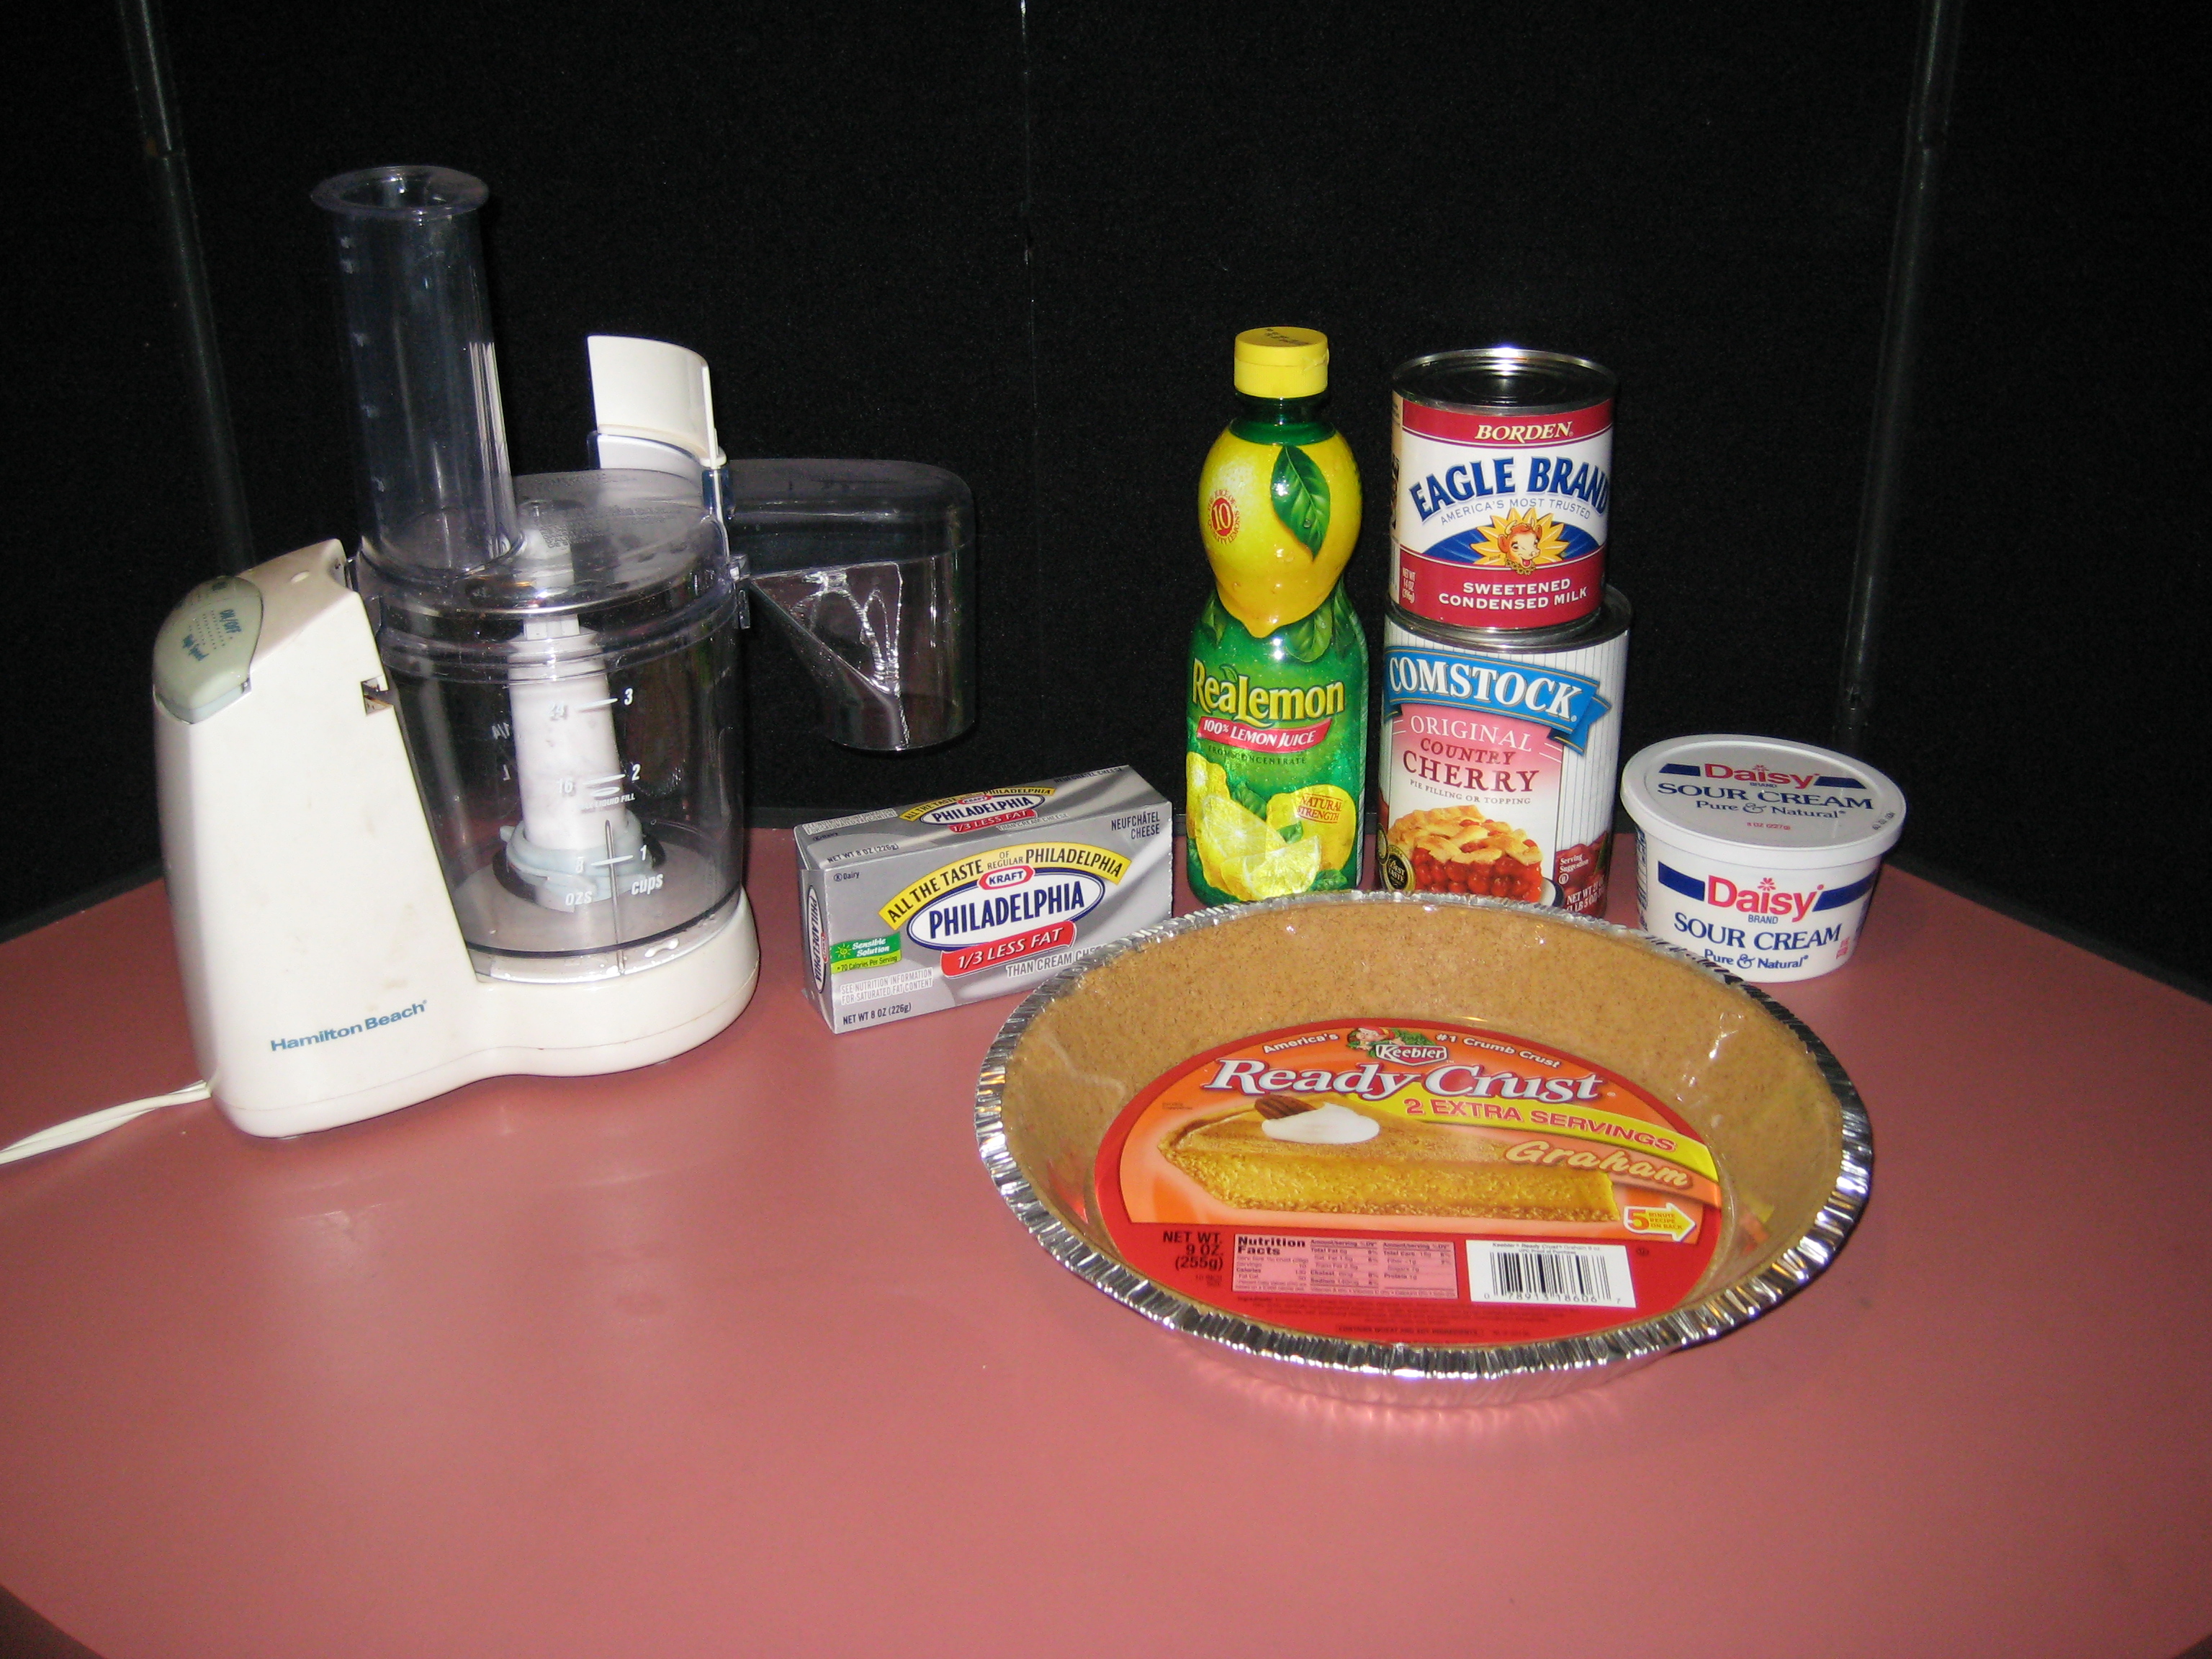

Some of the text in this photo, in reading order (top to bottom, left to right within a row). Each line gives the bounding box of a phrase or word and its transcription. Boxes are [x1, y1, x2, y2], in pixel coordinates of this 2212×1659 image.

[1475, 421, 1572, 444] BORDEN
[1408, 455, 1611, 523] EAGLE BRAND
[1213, 503, 1231, 529] 10
[1441, 498, 1591, 526] AMERICA'S MOST TRUSTED
[1439, 585, 1588, 610] CONDENSED MILK
[1462, 578, 1571, 596] SWEETENED
[624, 688, 634, 705] 3
[1192, 657, 1345, 728] ReaLemon
[1388, 655, 1583, 721] COMSTOCK
[1203, 719, 1316, 750] 100% LEMON JUICE
[1410, 714, 1532, 752] ORIGINAL
[1420, 737, 1516, 765] COUNTRY
[631, 763, 641, 781] 2
[1403, 750, 1539, 793] CHERRY
[1704, 763, 1817, 790] Daisy
[621, 793, 636, 804] FILL
[1410, 778, 1423, 790] PIE
[1425, 783, 1462, 801] FILLING
[1465, 795, 1480, 804] OR
[1658, 782, 1874, 810] SOUR CREAM
[904, 810, 917, 820] ALL
[916, 802, 932, 813] THE
[932, 797, 957, 807] TASTE
[932, 796, 1033, 823] PHILADELPHIA
[1297, 806, 1339, 821] STRENGTH
[1300, 796, 1342, 812] NATURAL
[1696, 800, 1839, 819] Pure & Natural
[953, 810, 1028, 833] 1/3 LESS FAT
[998, 814, 1068, 832] THAN CREAM CHEESE
[1130, 823, 1160, 840] CHEESE
[827, 853, 842, 863] NET
[874, 843, 900, 853] (226g)
[987, 856, 1024, 871] REGULAR
[999, 850, 1010, 859] OF
[843, 871, 860, 880] Dairy
[887, 848, 1123, 923] ALL THE TASTE PHILADELPHIA
[988, 871, 1024, 886] KRAFT
[1566, 891, 1582, 905] NET
[1707, 874, 1817, 922] Daisy
[929, 881, 1085, 939] PHILADELPHIA
[1748, 914, 1779, 924] BRAND
[809, 895, 822, 983] PHILADELPHIA
[1674, 912, 1745, 950] SOUR
[1753, 922, 1843, 951] CREAM
[852, 938, 886, 950] Sensible
[856, 946, 890, 958] Solution
[957, 927, 1064, 970] 1/3 LESS FAT
[849, 961, 868, 970] Calories
[878, 956, 898, 966] Serving
[1007, 956, 1073, 978] THAN CREAM
[1704, 948, 1803, 969] Pure & Natural
[841, 968, 932, 994] SEE NUTRITION INFORMATION
[842, 979, 932, 1004] FOR SATURATED FAT CONTENT
[842, 1002, 912, 1025] NET WT 8 OZ (226g)
[271, 1003, 426, 1052] Hamilton Beach
[1263, 1031, 1561, 1069] America's #1 Crumb Crust
[1378, 1044, 1446, 1061] Keebler
[1202, 1058, 1604, 1102] Ready Crust
[1403, 1099, 1678, 1151] 2 EXTRA SERVINGS
[1505, 1141, 1689, 1187] Graham
[1627, 1208, 1650, 1231] 5
[1163, 1231, 1223, 1244] NET WT.
[1238, 1236, 1305, 1248] Nutrition
[1186, 1244, 1195, 1256] 9
[1238, 1246, 1280, 1255] Facts
[1174, 1256, 1223, 1271] (255g)
